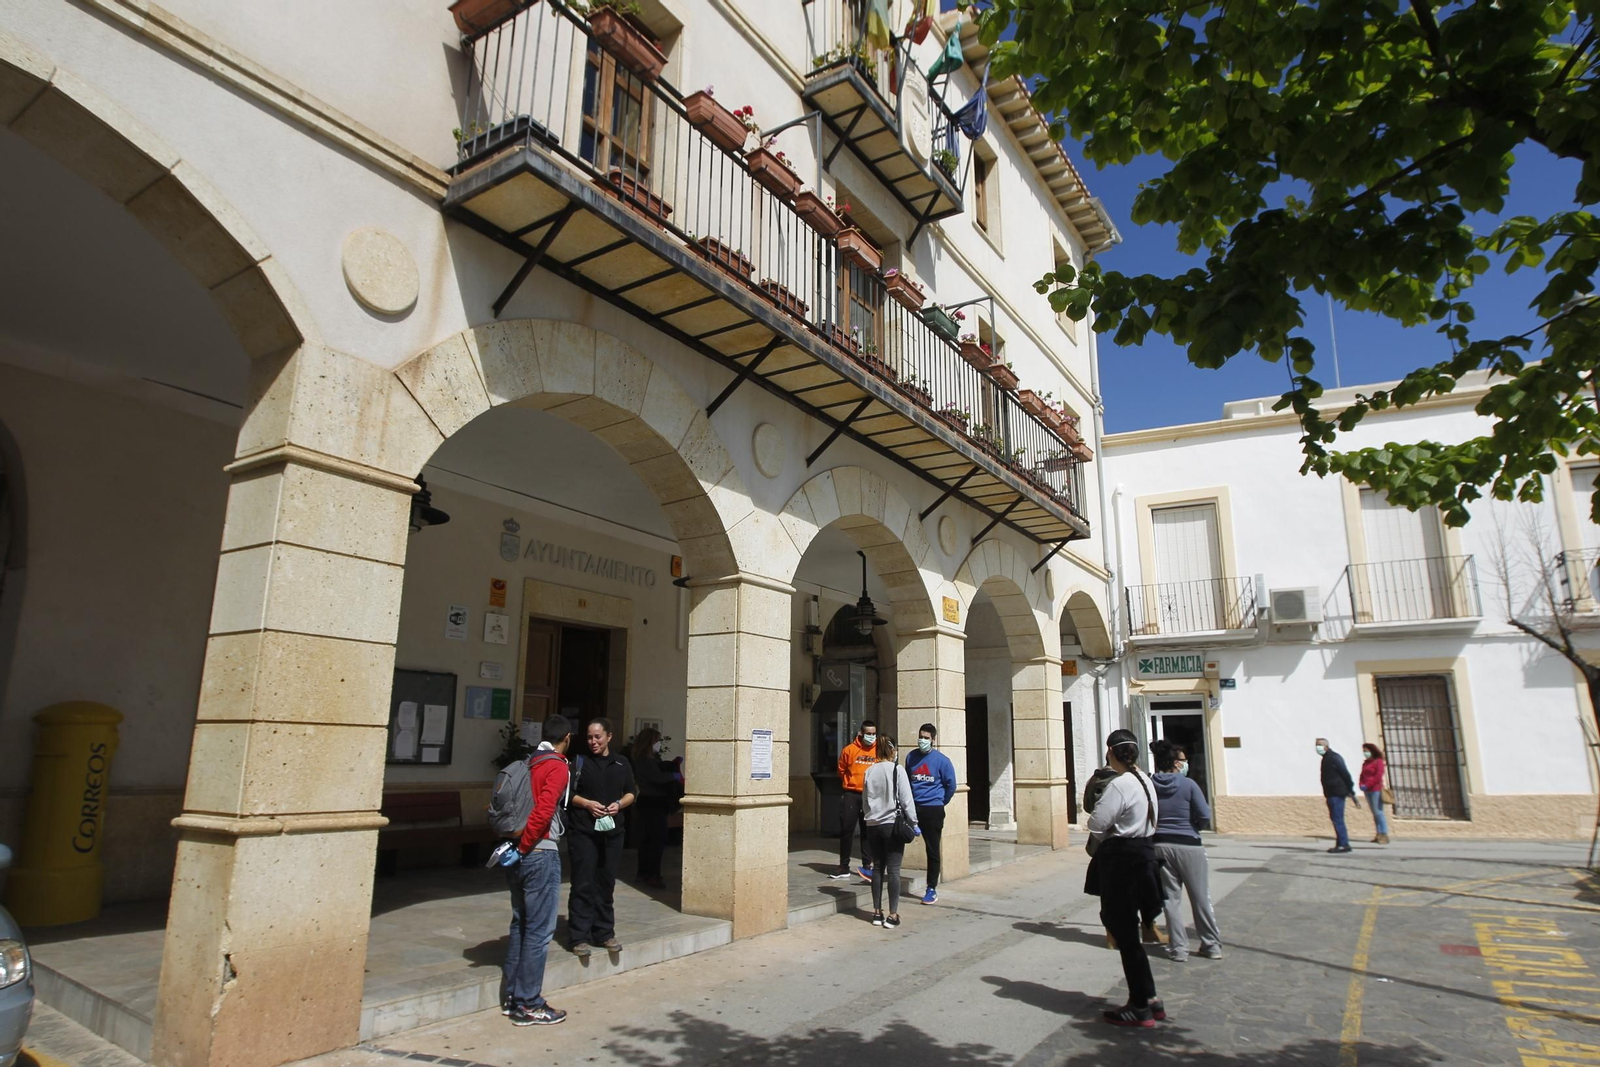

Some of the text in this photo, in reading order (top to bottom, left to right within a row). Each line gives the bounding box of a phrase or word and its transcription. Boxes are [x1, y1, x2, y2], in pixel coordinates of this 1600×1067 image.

[523, 538, 656, 588] AYUNTAMIENTO
[1154, 655, 1203, 674] FARMACIA
[72, 742, 106, 854] CORREOS
